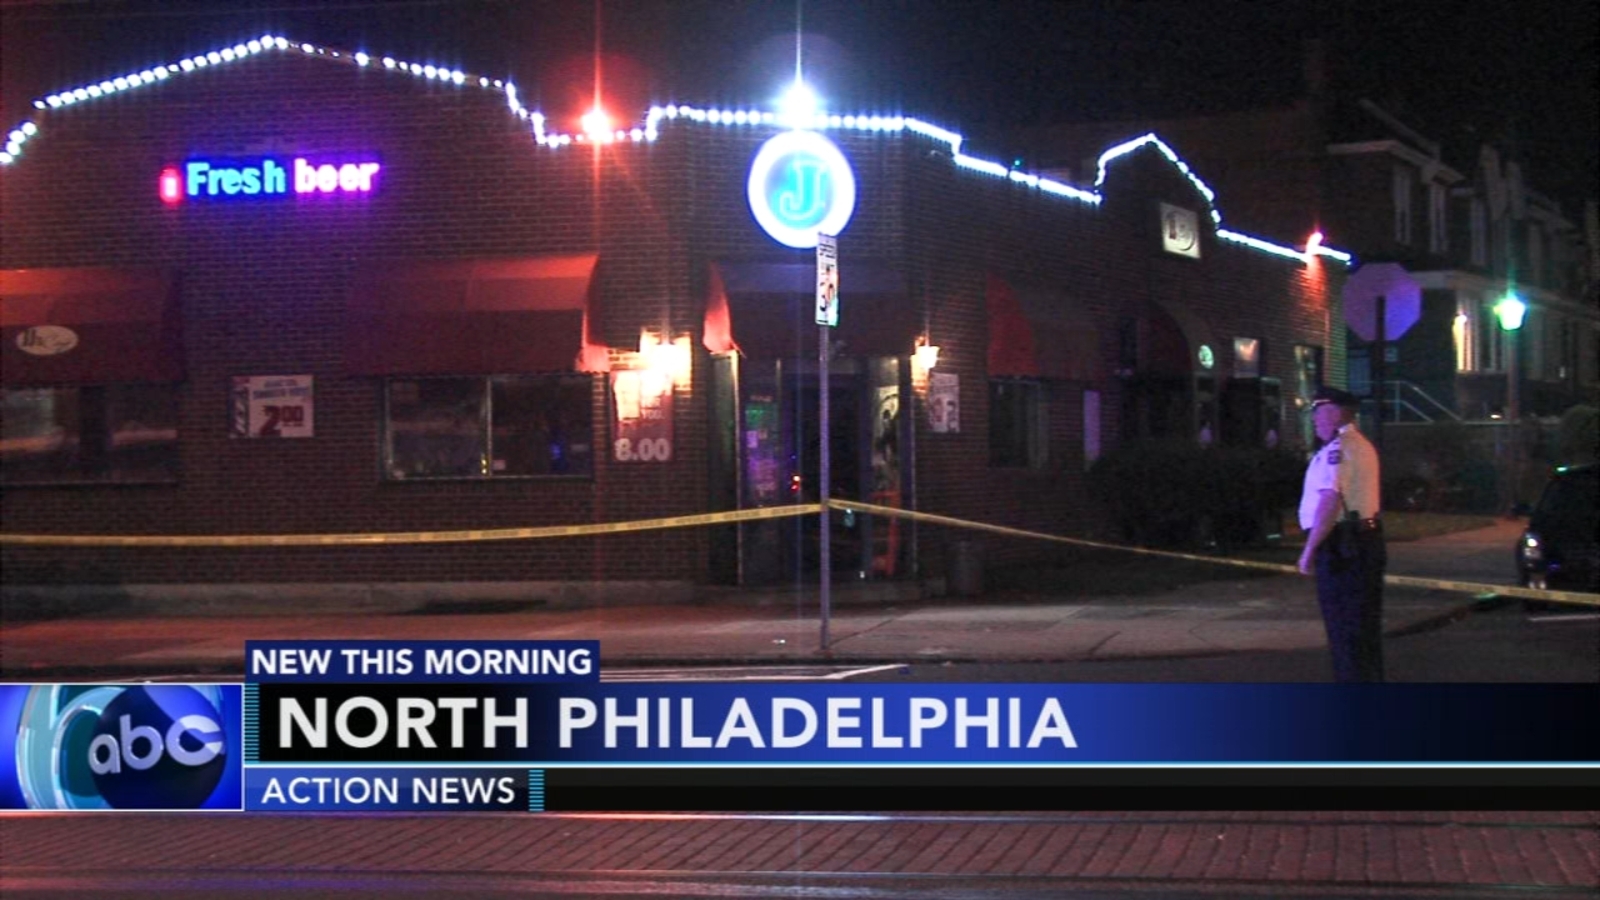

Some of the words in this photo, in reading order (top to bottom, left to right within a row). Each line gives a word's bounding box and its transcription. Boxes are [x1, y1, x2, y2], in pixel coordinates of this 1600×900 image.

[186, 159, 286, 196] Fresh
[294, 157, 381, 194] beer
[614, 438, 671, 462] 8.00
